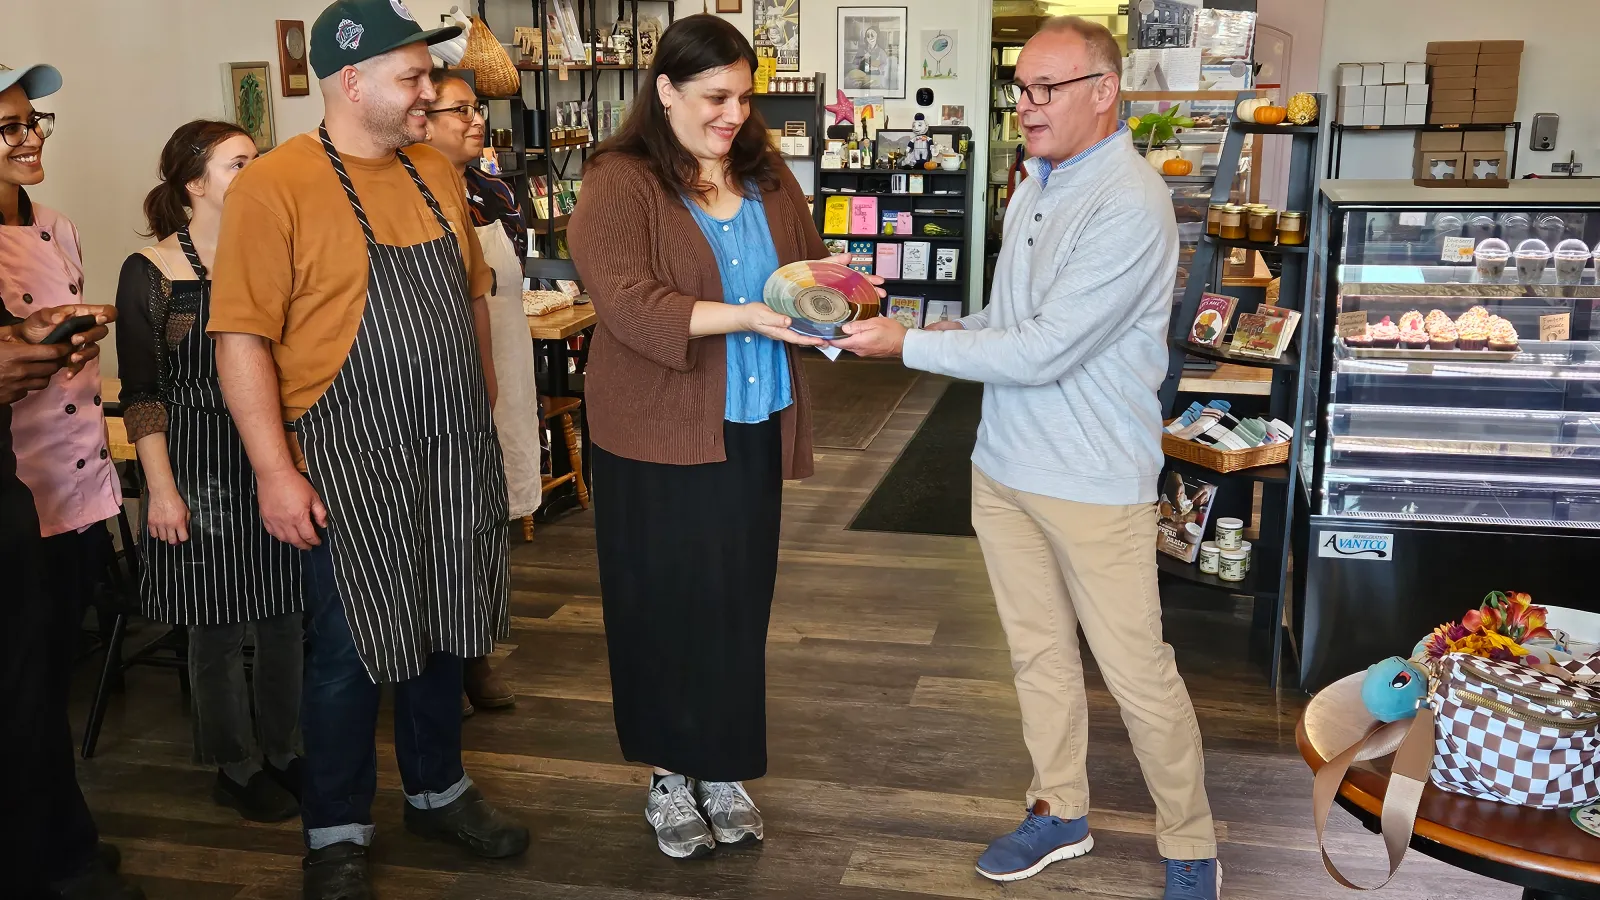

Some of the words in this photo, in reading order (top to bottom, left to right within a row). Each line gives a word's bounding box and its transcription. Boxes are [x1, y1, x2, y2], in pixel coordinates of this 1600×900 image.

[757, 47, 774, 57] NEW
[894, 298, 917, 307] HOPE
[1166, 536, 1189, 550] pantry
[1323, 534, 1387, 557] AVANTCO
